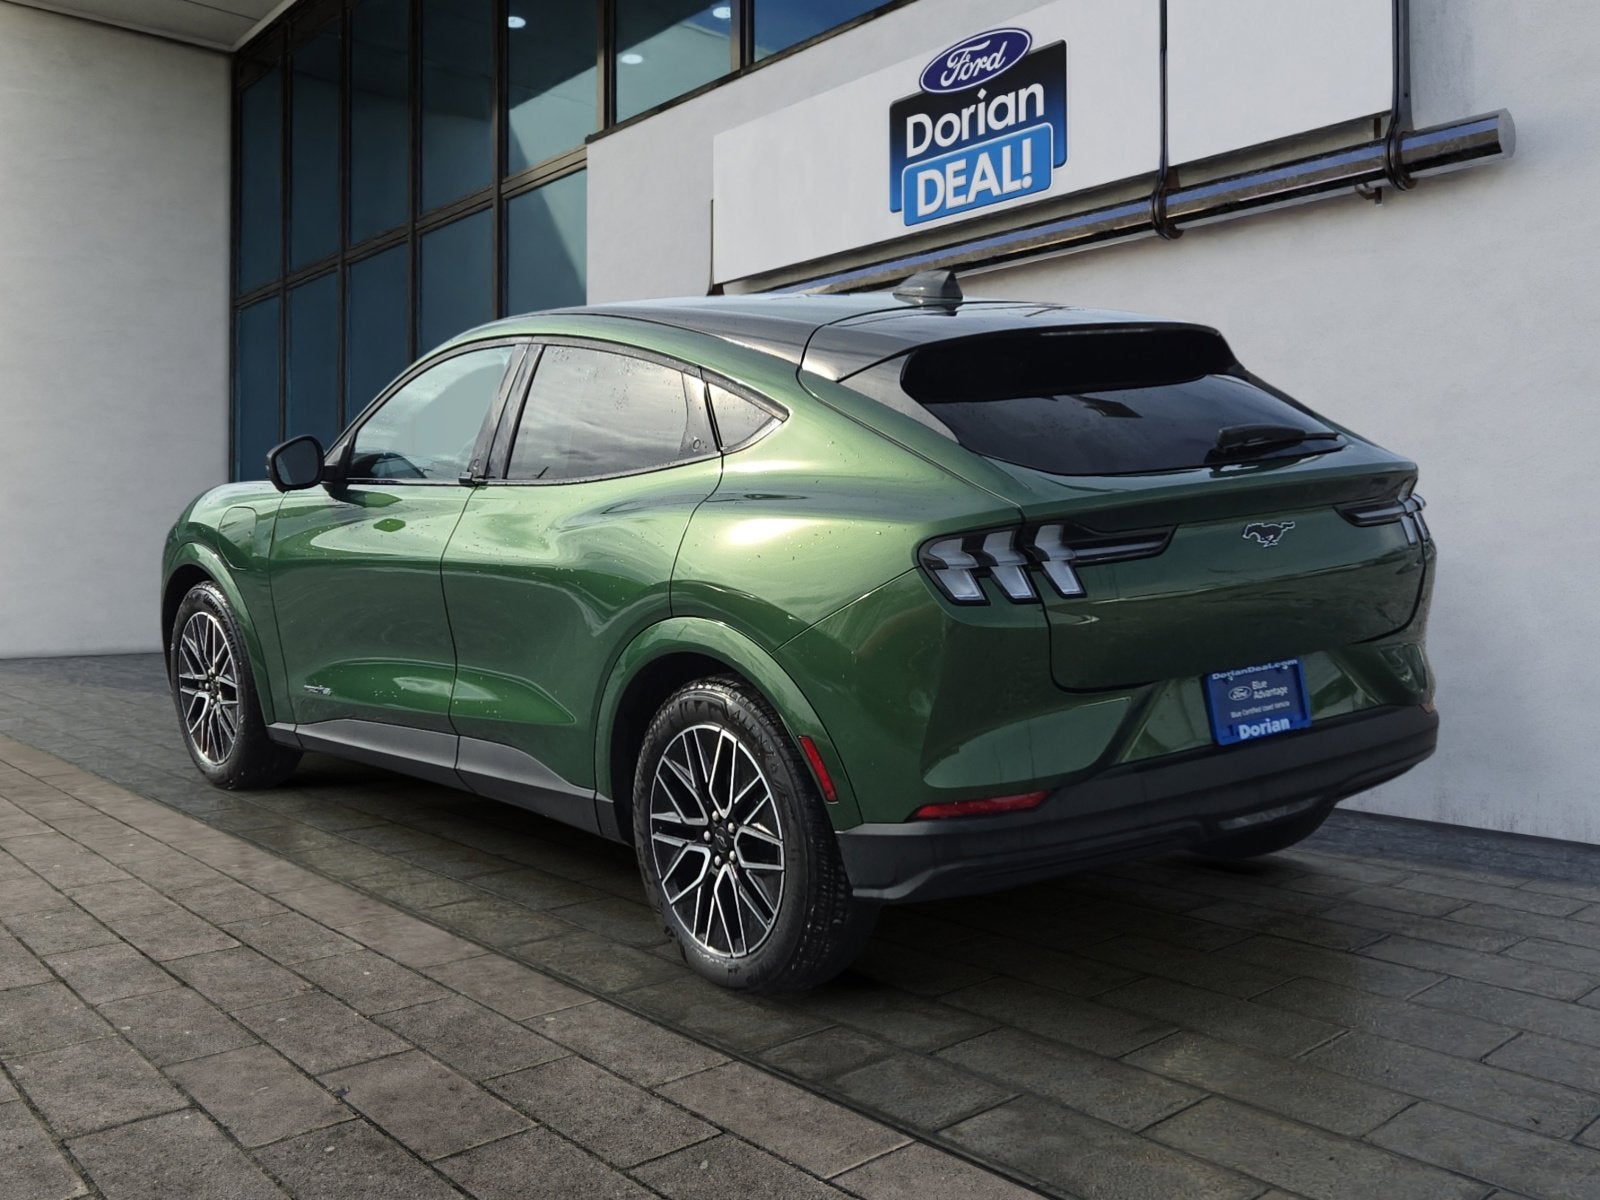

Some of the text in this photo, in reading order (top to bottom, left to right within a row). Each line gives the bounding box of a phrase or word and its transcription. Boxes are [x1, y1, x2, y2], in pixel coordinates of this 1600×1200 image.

[940, 40, 1007, 87] Ford
[906, 83, 1044, 158] Dorian
[917, 138, 1032, 217] DEAL!
[1238, 718, 1290, 740] Dorian
